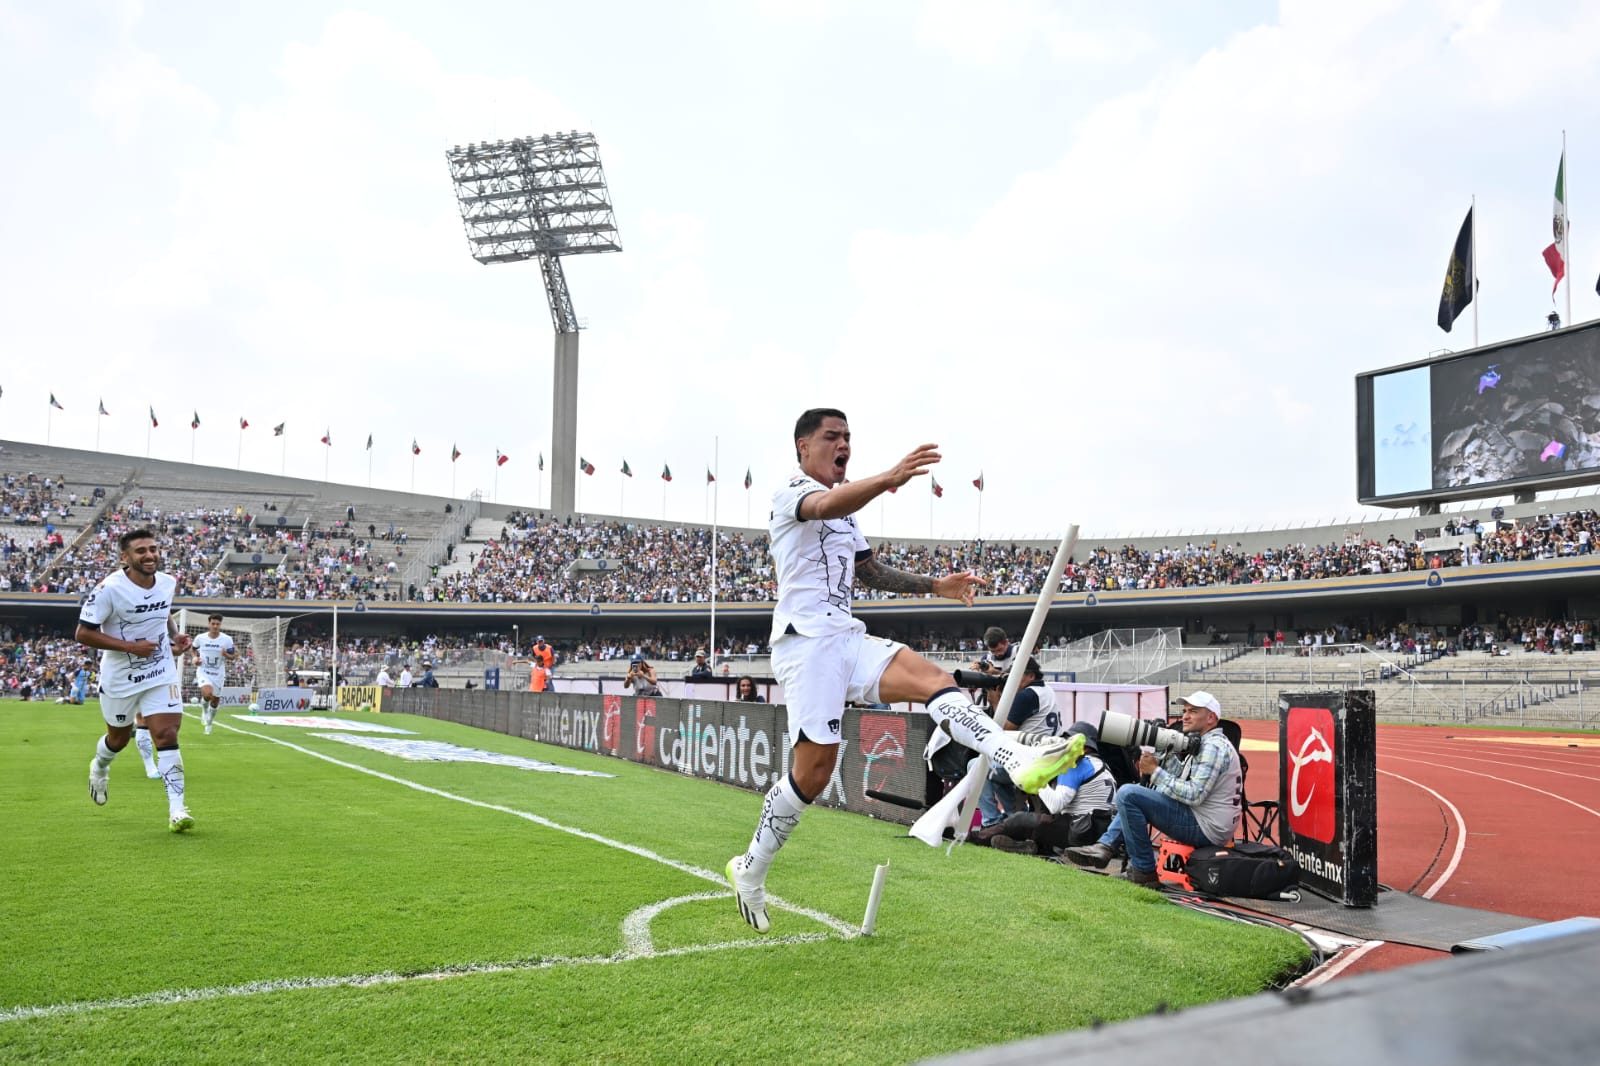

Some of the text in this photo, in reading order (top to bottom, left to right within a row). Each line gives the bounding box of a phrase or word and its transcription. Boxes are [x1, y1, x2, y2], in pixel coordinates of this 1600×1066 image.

[135, 600, 168, 613] DHL
[264, 699, 294, 711] BBVA
[341, 687, 376, 708] BARDAHL
[1283, 844, 1342, 884] liente.mx
